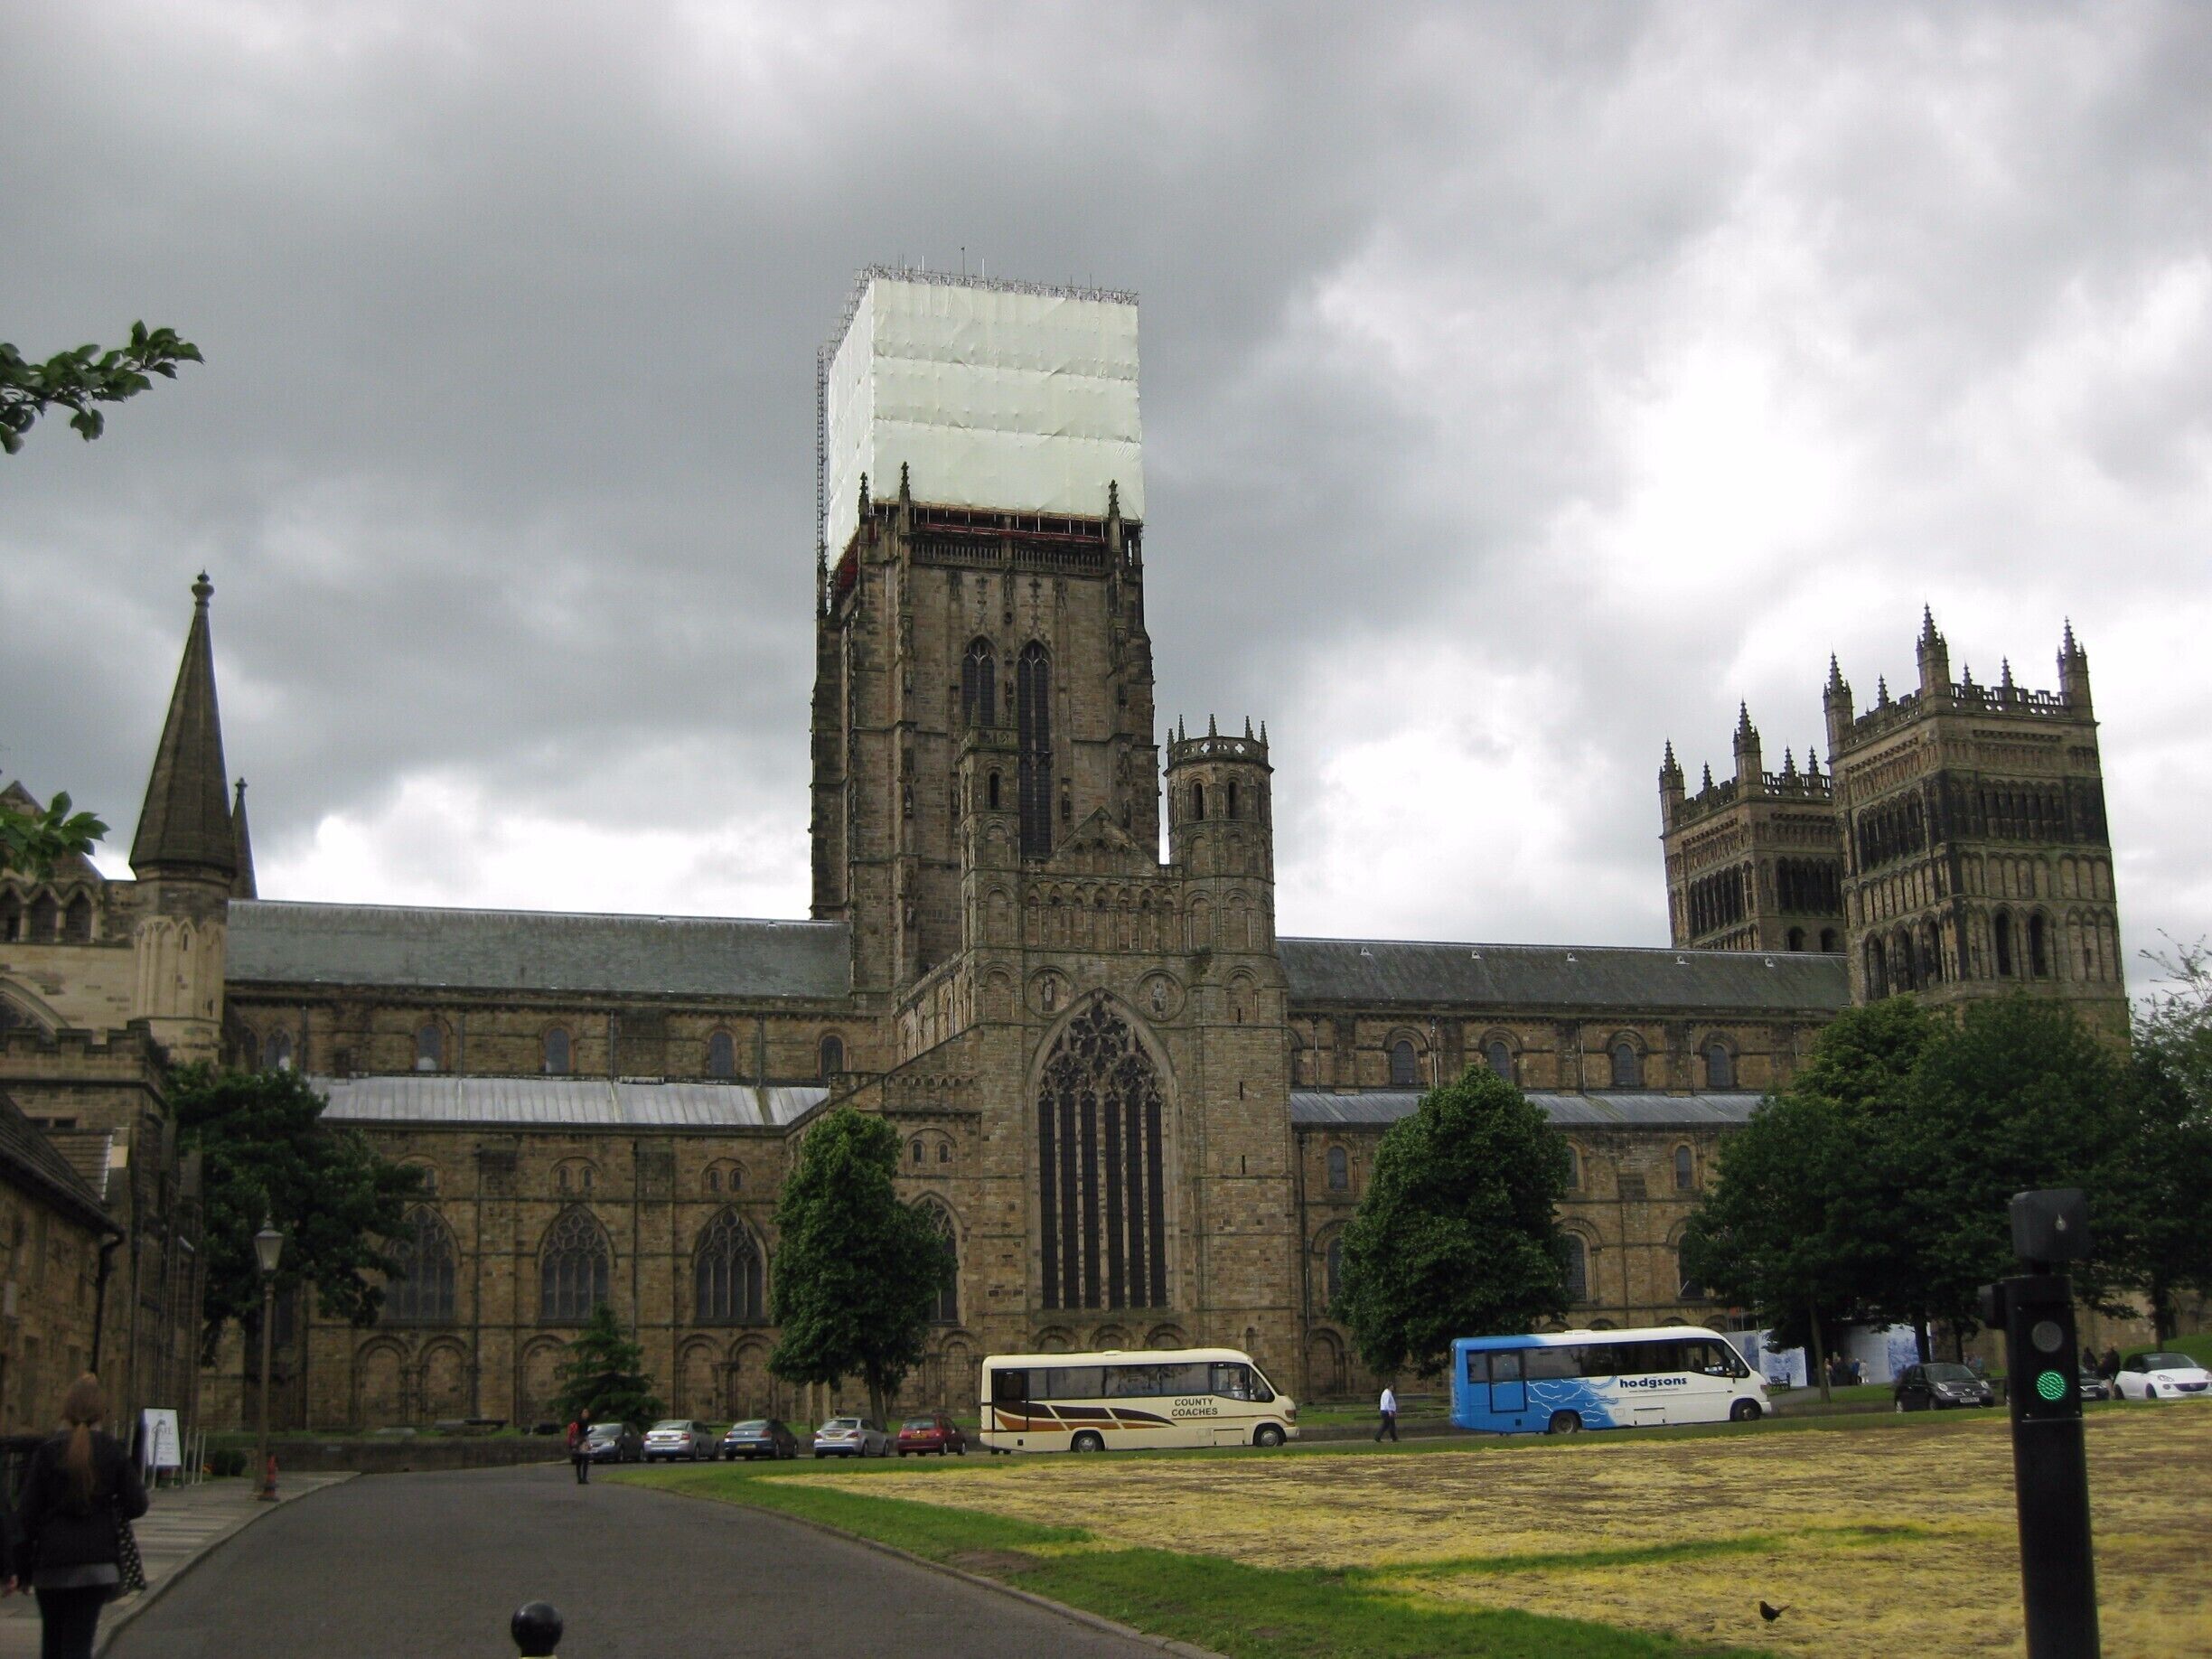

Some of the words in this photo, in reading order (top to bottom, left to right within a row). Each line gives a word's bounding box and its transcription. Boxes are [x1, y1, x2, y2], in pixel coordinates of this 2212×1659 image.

[1619, 1377, 1688, 1388] hodgsons
[1174, 1397, 1214, 1406] COUNTY
[1171, 1407, 1218, 1416] COACHES
